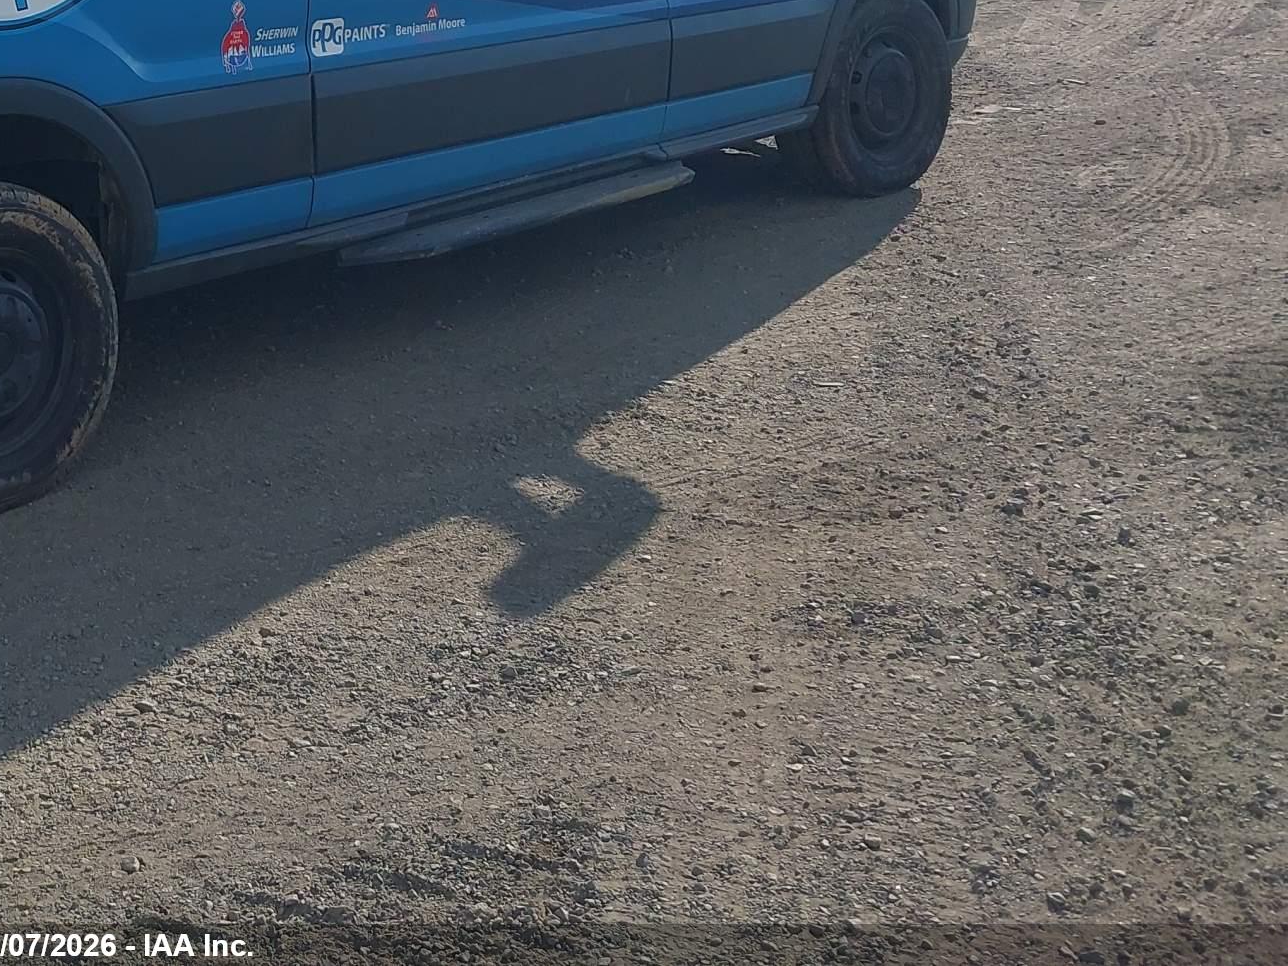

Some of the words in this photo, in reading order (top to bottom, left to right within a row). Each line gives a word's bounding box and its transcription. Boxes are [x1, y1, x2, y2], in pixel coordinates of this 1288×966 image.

[255, 26, 298, 41] SHERWIN
[344, 24, 386, 43] PAINTS
[395, 21, 436, 37] Benjamin
[439, 18, 466, 30] Moore
[252, 43, 295, 58] WILLIAMS
